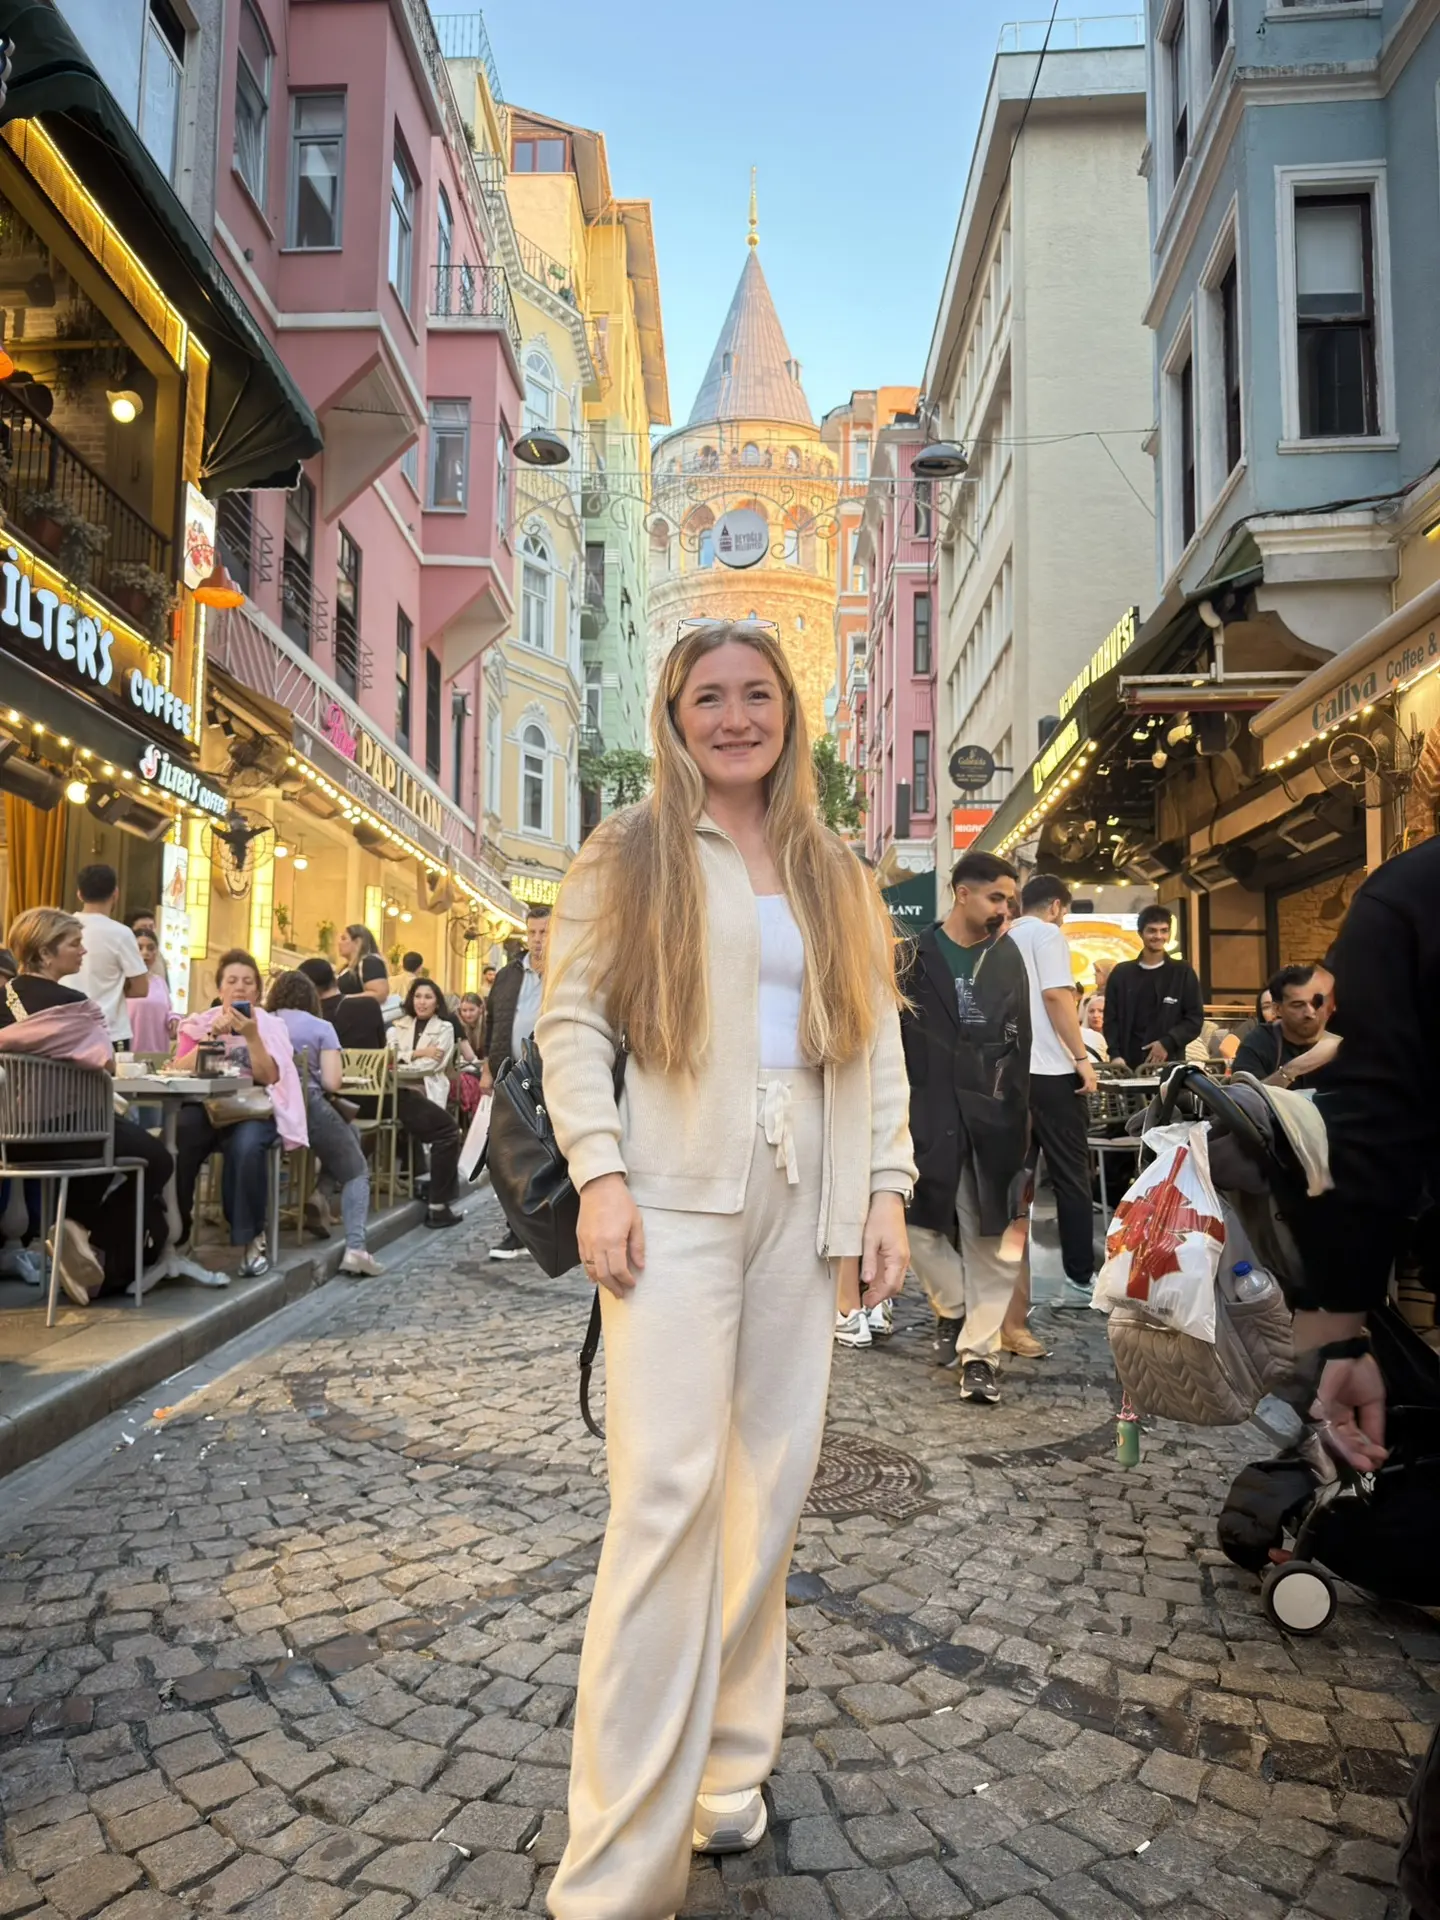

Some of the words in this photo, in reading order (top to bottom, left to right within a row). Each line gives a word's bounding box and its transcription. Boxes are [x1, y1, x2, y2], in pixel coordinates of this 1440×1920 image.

[1386, 645, 1424, 683] Coffee
[1428, 631, 1438, 656] &
[130, 668, 192, 736] COFFEE
[199, 786, 228, 816] COFFEE
